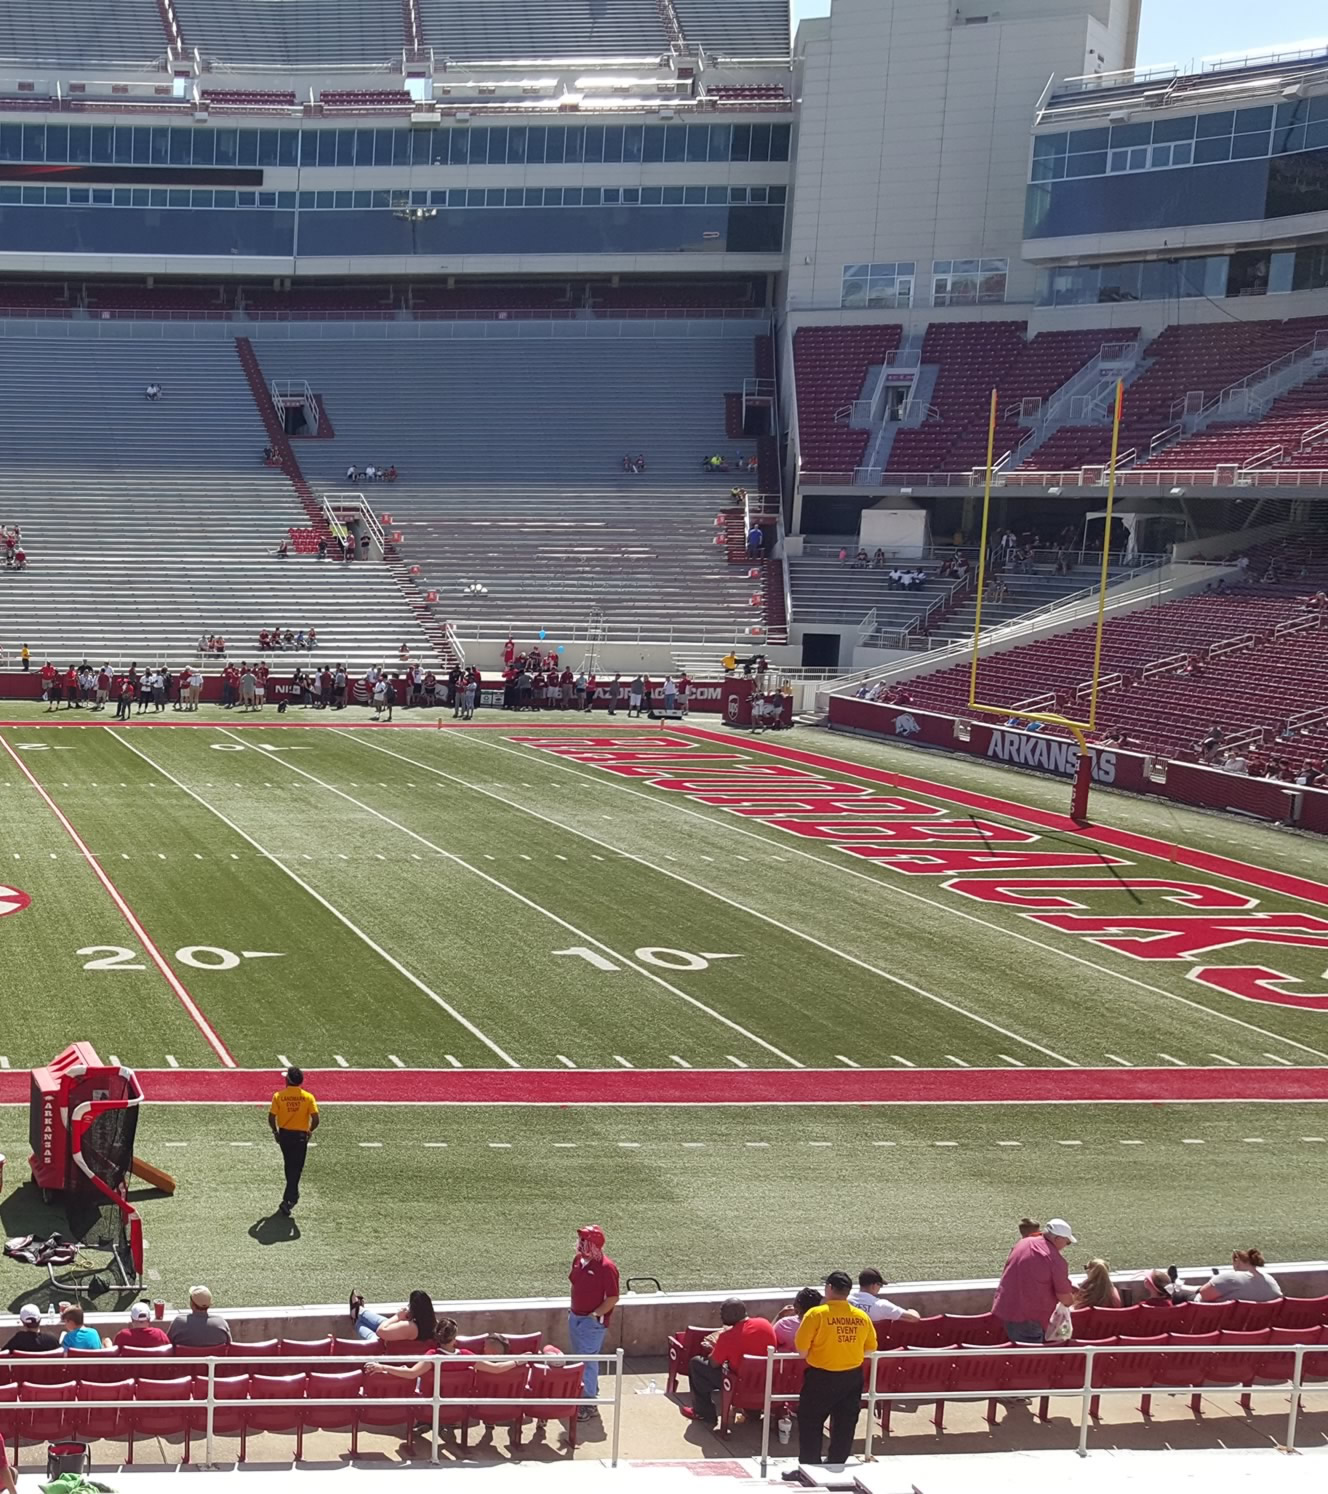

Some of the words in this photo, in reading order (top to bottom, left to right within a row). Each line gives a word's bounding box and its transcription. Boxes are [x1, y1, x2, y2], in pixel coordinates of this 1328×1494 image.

[44, 1101, 53, 1164] ARKANSAS
[827, 1317, 865, 1326] LANDMARK
[836, 1326, 858, 1335] EVENT
[838, 1335, 857, 1343] STAFF
